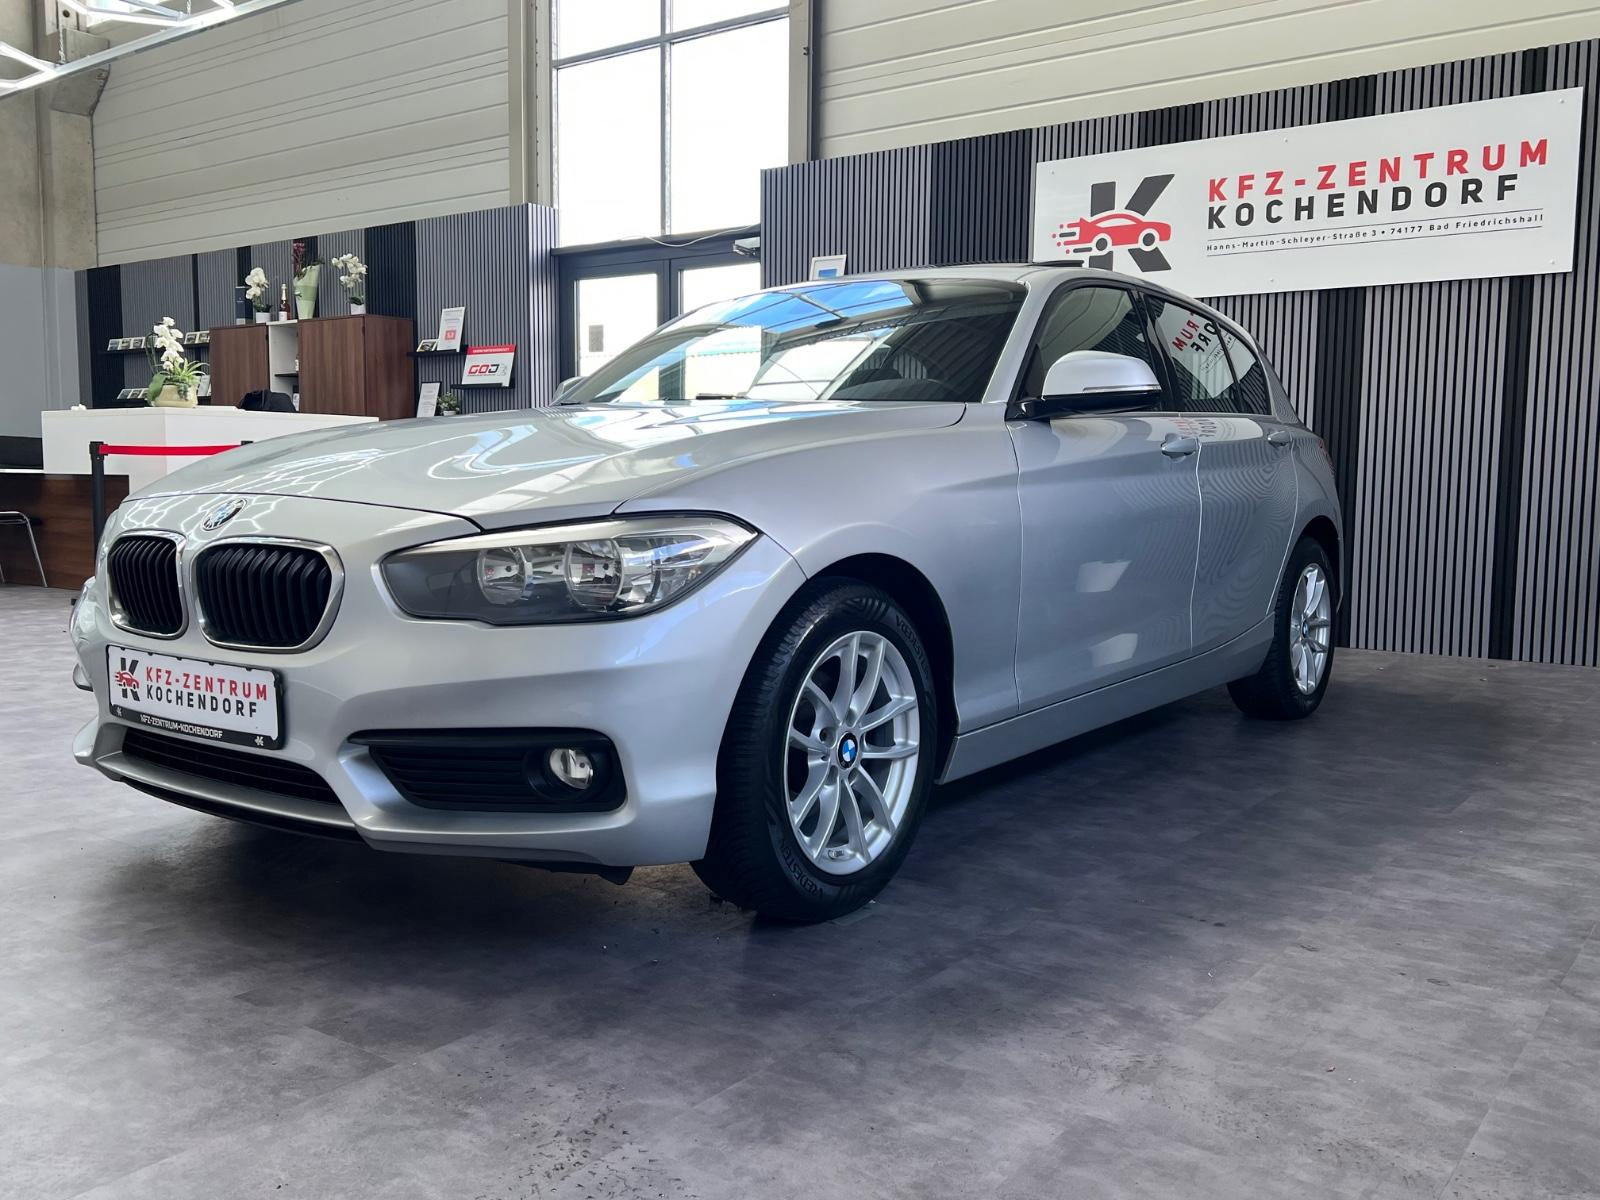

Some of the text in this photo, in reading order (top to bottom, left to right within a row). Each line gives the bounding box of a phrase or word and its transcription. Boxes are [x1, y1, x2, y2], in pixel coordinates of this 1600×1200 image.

[1207, 137, 1549, 203] KFZ-ZENTRUM
[1207, 173, 1519, 230] KOCHENDORF
[1206, 214, 1544, 251] Hanns-Martin-Schleyer-Straße 3 74177 Bad Friedrichshall
[145, 666, 267, 701] KFZ-ZENTRUM
[146, 684, 257, 718] KOCHENDORF
[139, 713, 223, 739] KFZ-ZENTRUM-KOCHENDORF
